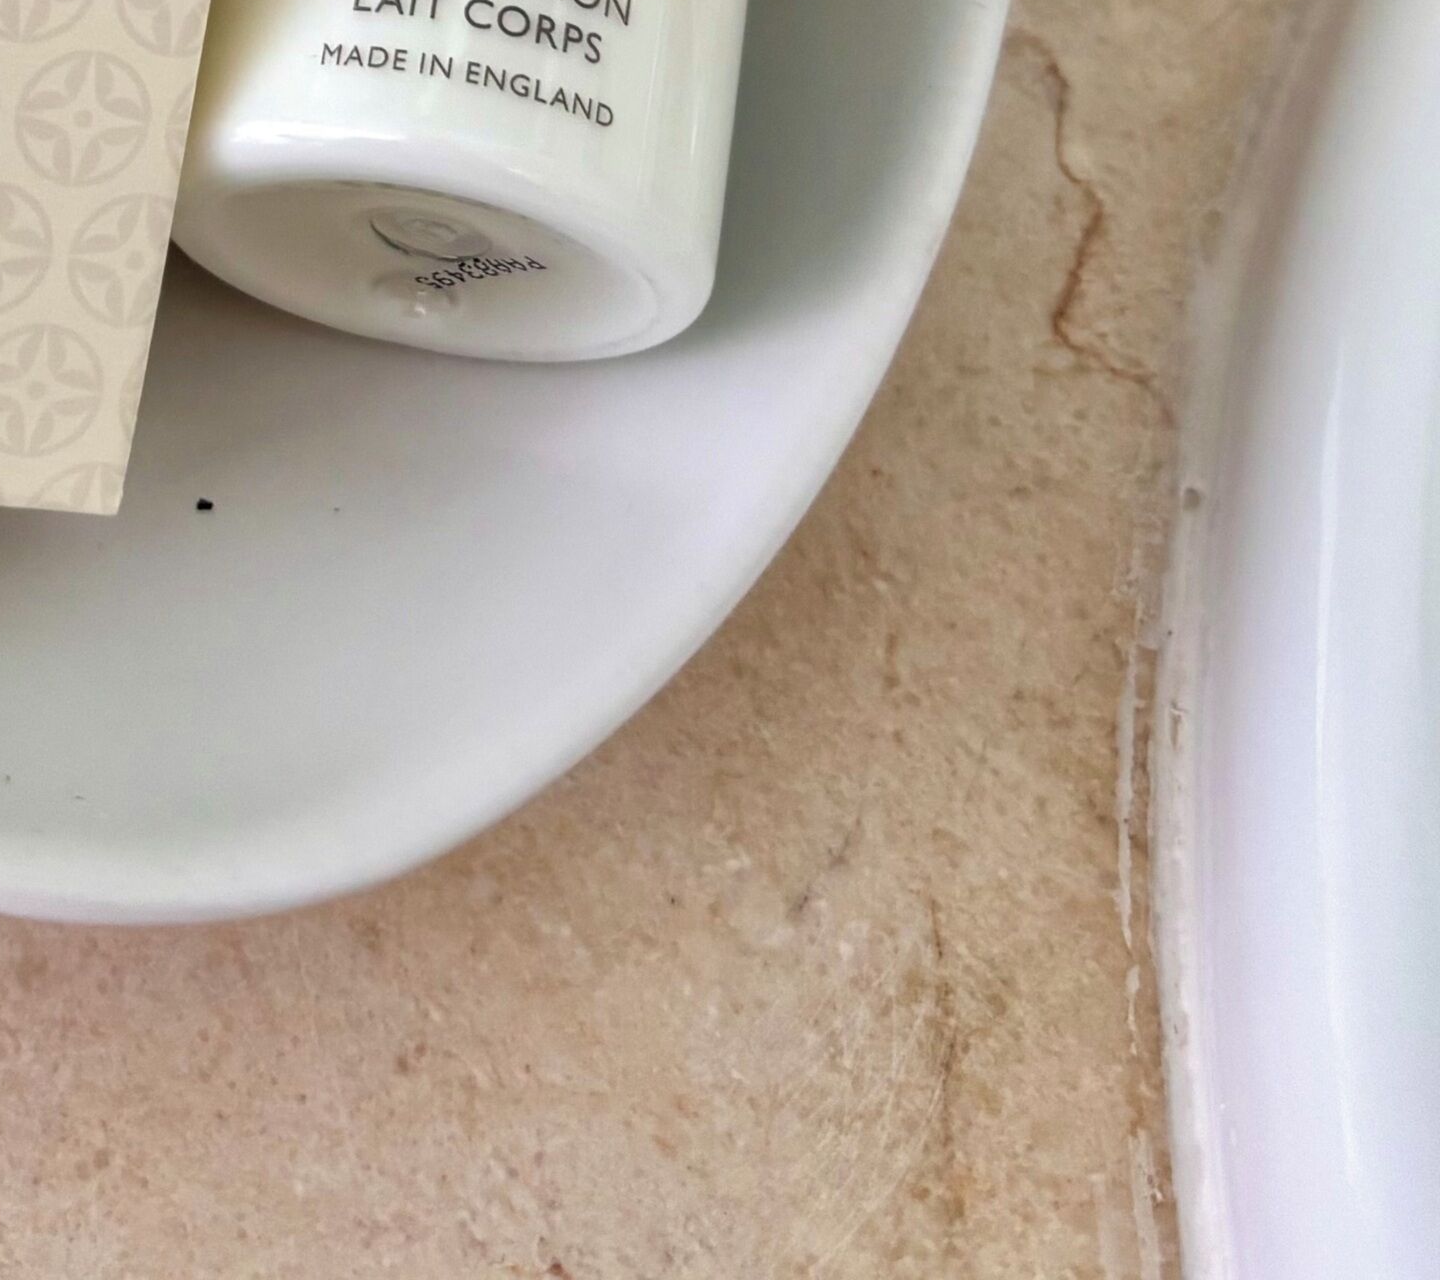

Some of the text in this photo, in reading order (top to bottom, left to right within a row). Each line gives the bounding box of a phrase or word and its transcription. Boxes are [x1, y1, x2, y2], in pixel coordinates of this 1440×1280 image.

[320, 43, 615, 128] MADE IN ENGLAND
